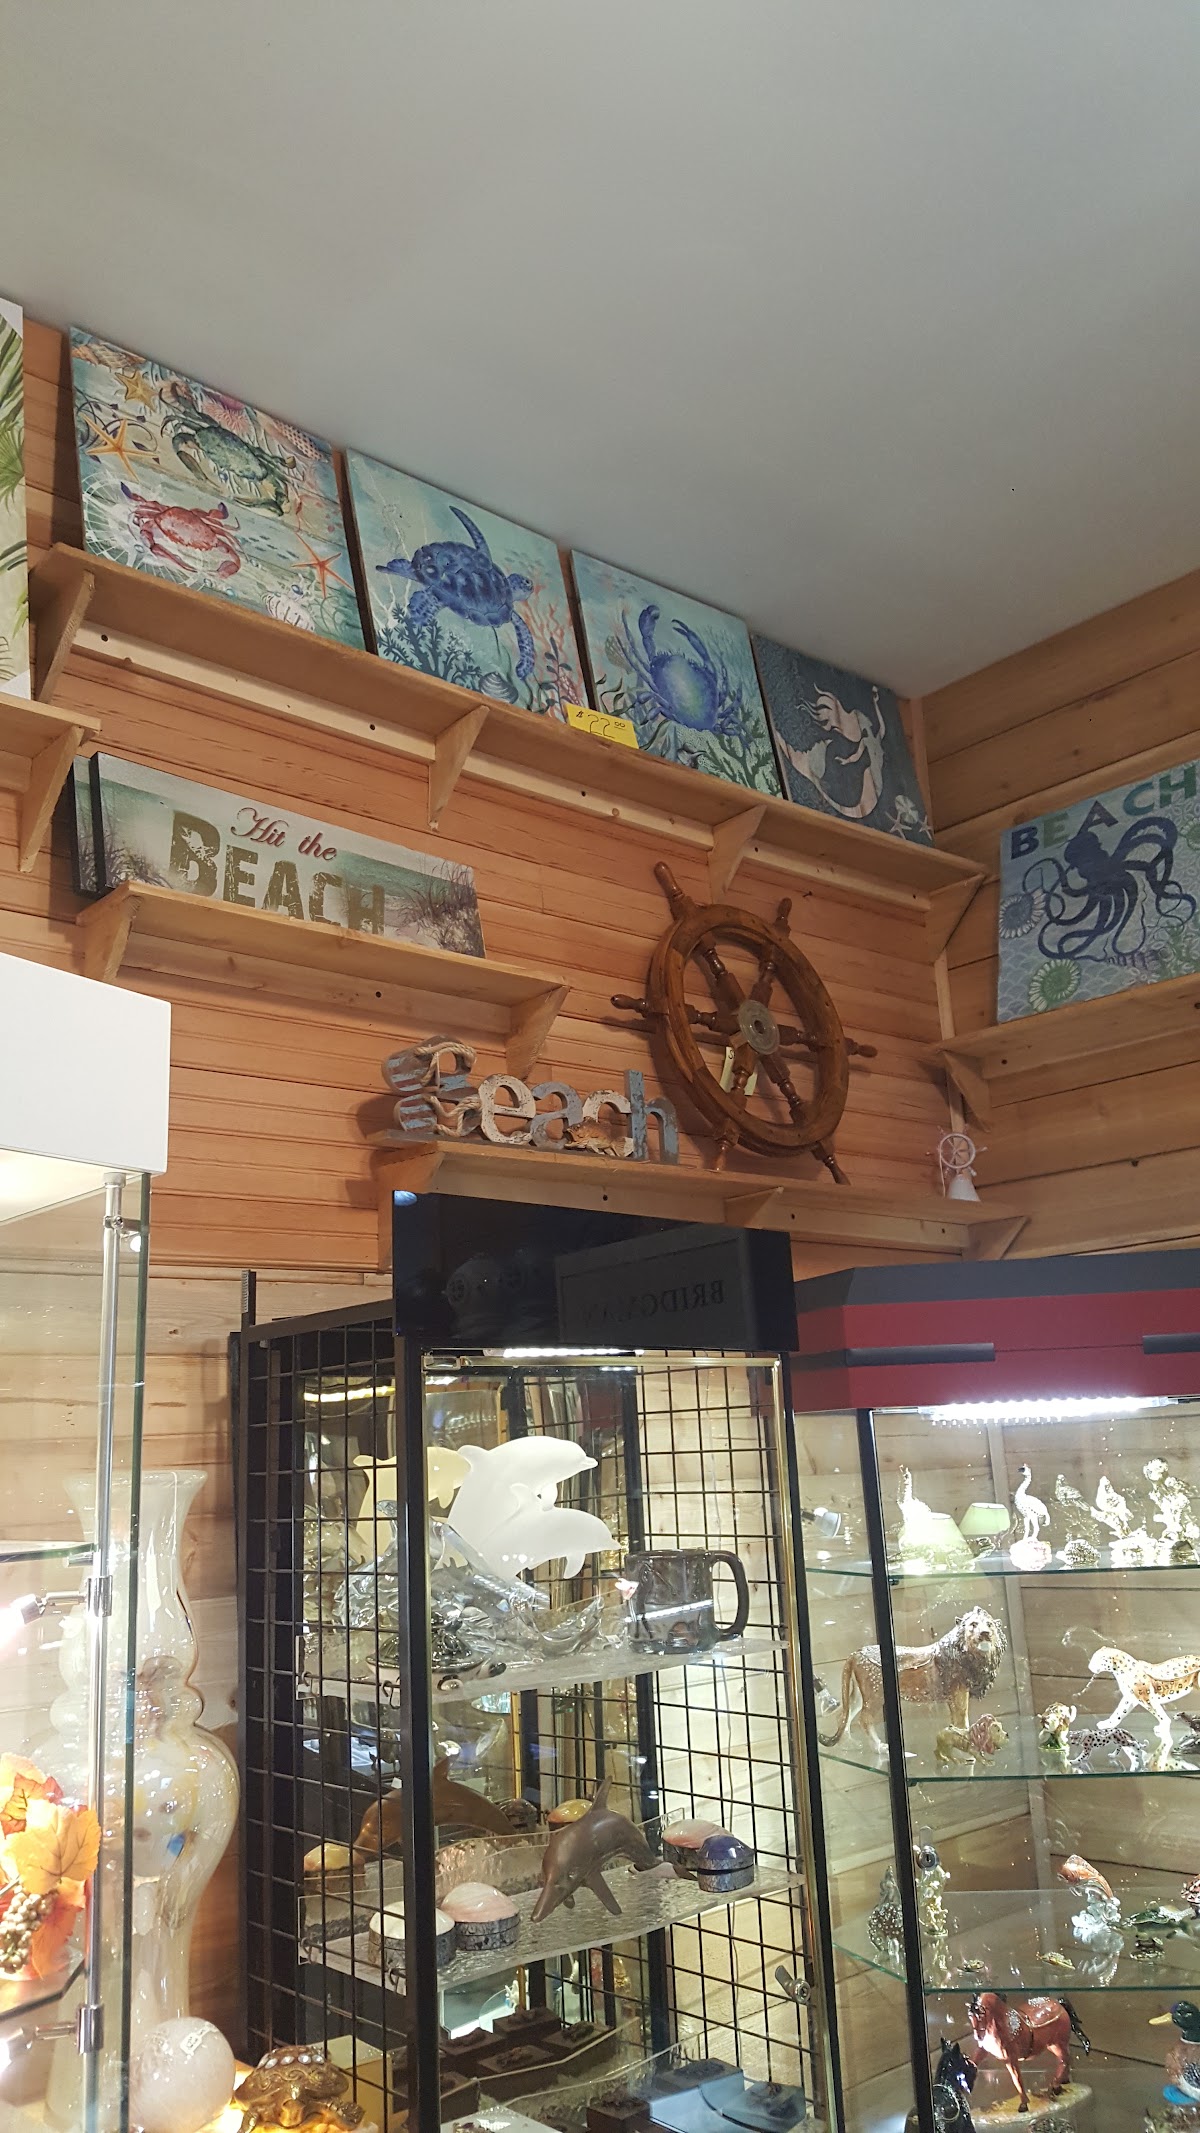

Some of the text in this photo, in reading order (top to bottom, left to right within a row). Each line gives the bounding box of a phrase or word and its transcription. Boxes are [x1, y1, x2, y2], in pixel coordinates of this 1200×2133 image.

[230, 806, 338, 862] Hit the
[1010, 765, 1197, 860] BEACH
[169, 809, 386, 936] BEACH
